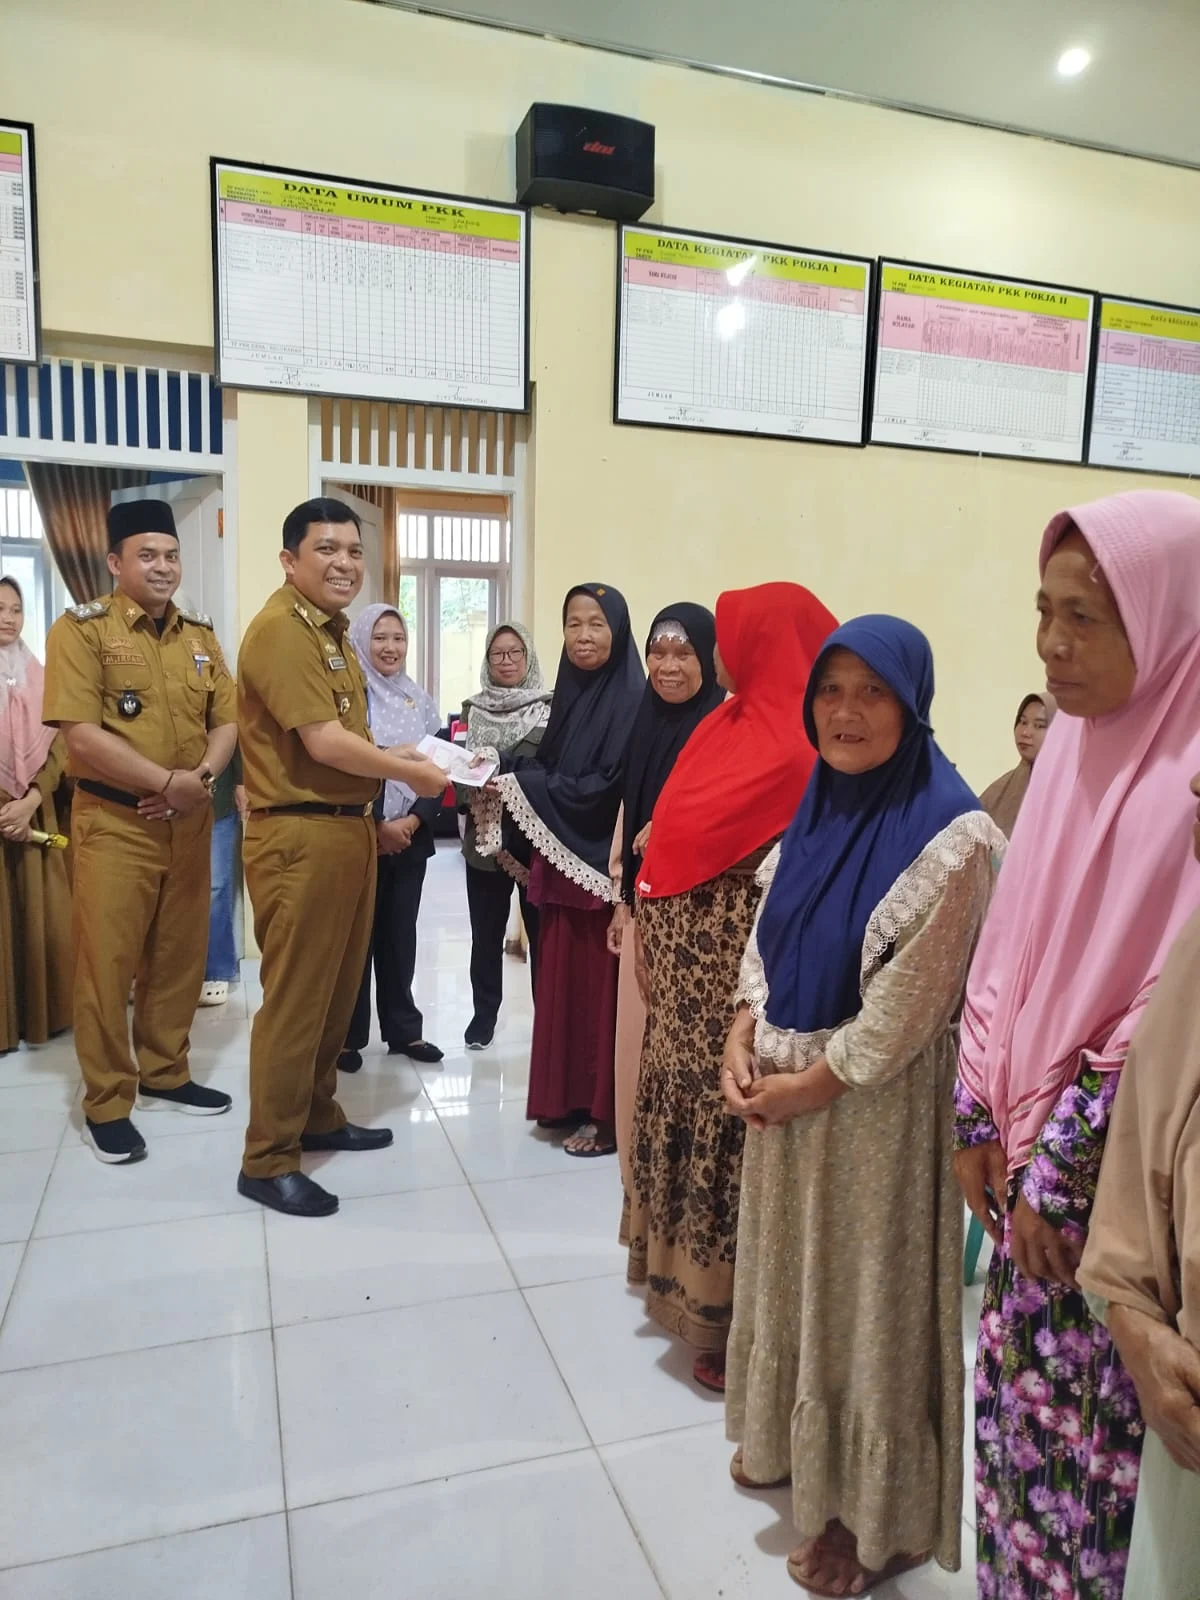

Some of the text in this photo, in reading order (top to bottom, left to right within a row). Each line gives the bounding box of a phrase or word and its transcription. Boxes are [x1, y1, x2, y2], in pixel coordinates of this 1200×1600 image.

[284, 183, 338, 198] DATA
[347, 193, 413, 210] UMUM
[422, 203, 465, 218] PKK
[657, 239, 689, 252] DATA
[762, 254, 789, 265] PKK
[792, 258, 828, 272] POKJA
[833, 264, 838, 273] I
[908, 273, 936, 284] DATA
[939, 278, 995, 293] KEGIATAN
[998, 286, 1021, 297] PKK
[1024, 291, 1056, 304] POKJA
[1059, 297, 1067, 305] II
